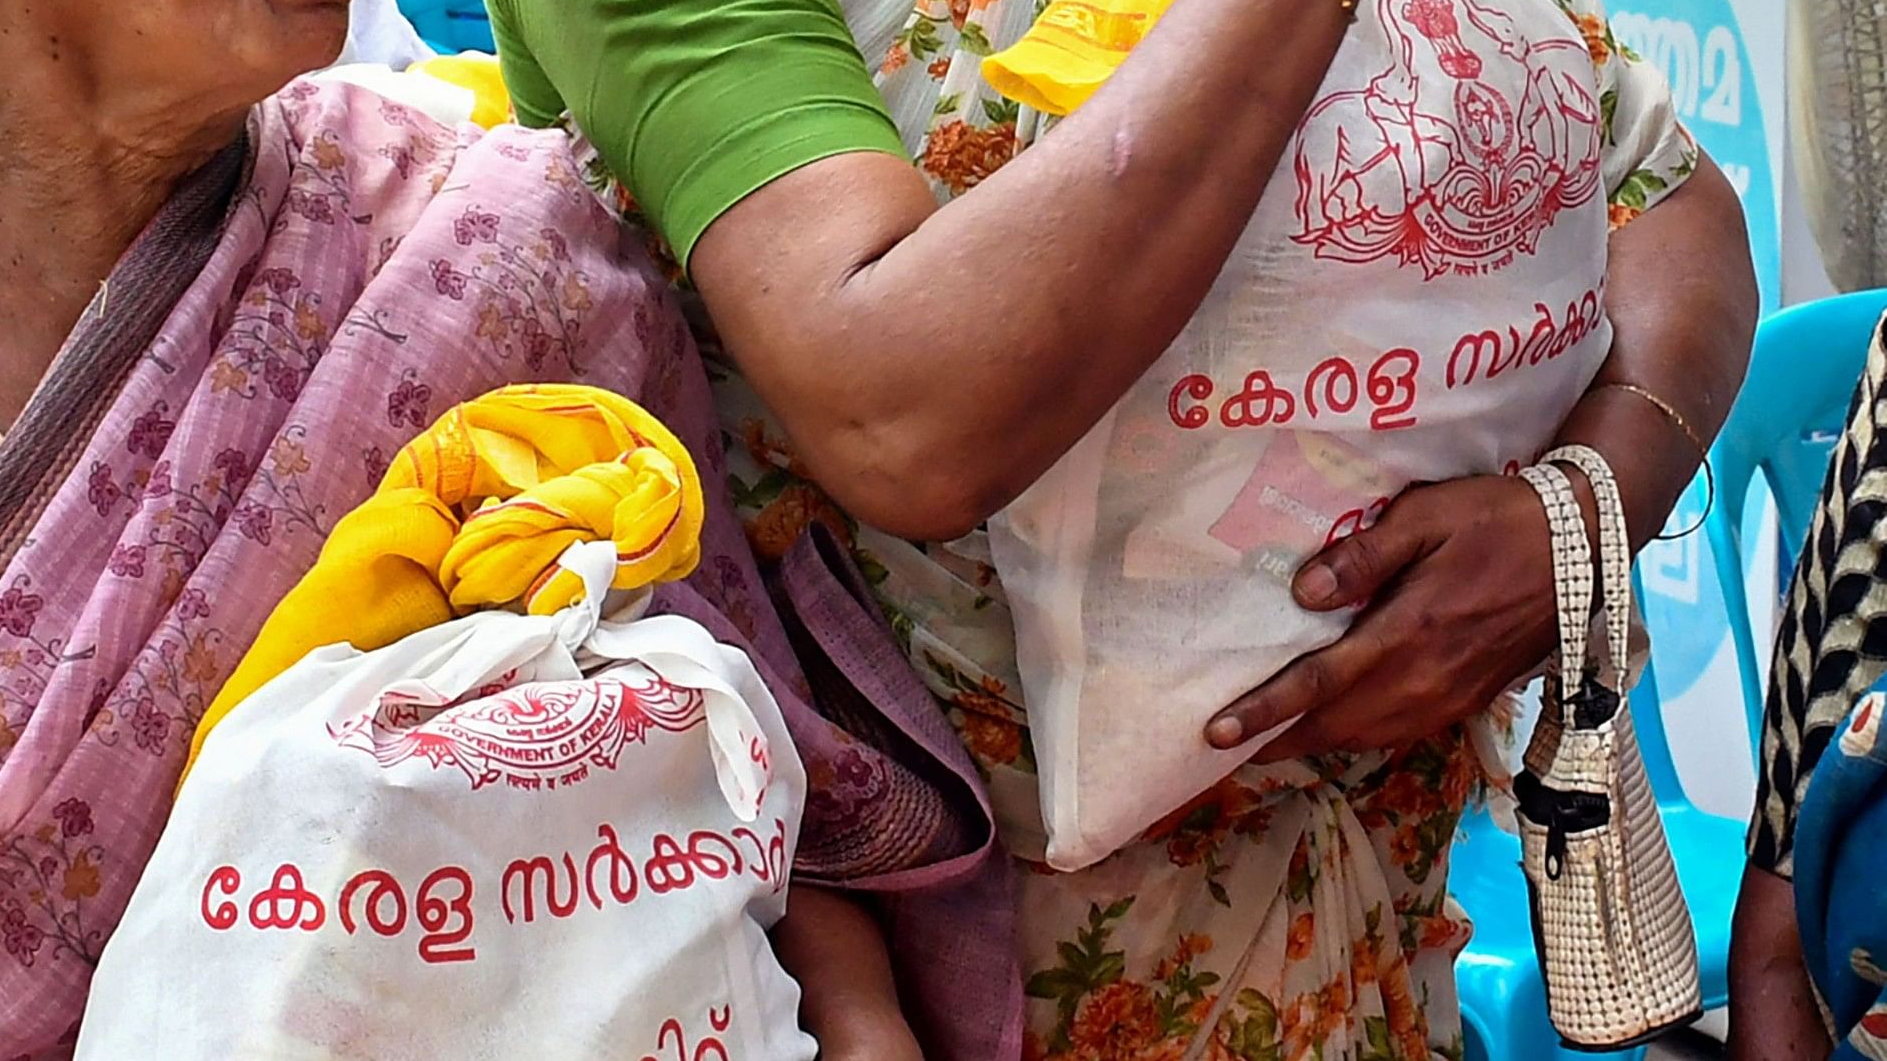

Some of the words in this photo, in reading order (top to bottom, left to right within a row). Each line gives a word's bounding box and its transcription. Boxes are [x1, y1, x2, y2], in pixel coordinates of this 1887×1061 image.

[1423, 213, 1491, 252] GOVERNMENT
[1494, 229, 1511, 246] OF
[1167, 347, 1421, 431] കേരള
[437, 725, 555, 762] GOVERNMENT
[559, 737, 578, 758] OF
[579, 694, 618, 747] KERALA
[561, 763, 590, 787] जयते
[200, 863, 478, 964] കേരള
[501, 819, 787, 925] സർക്കാർ
